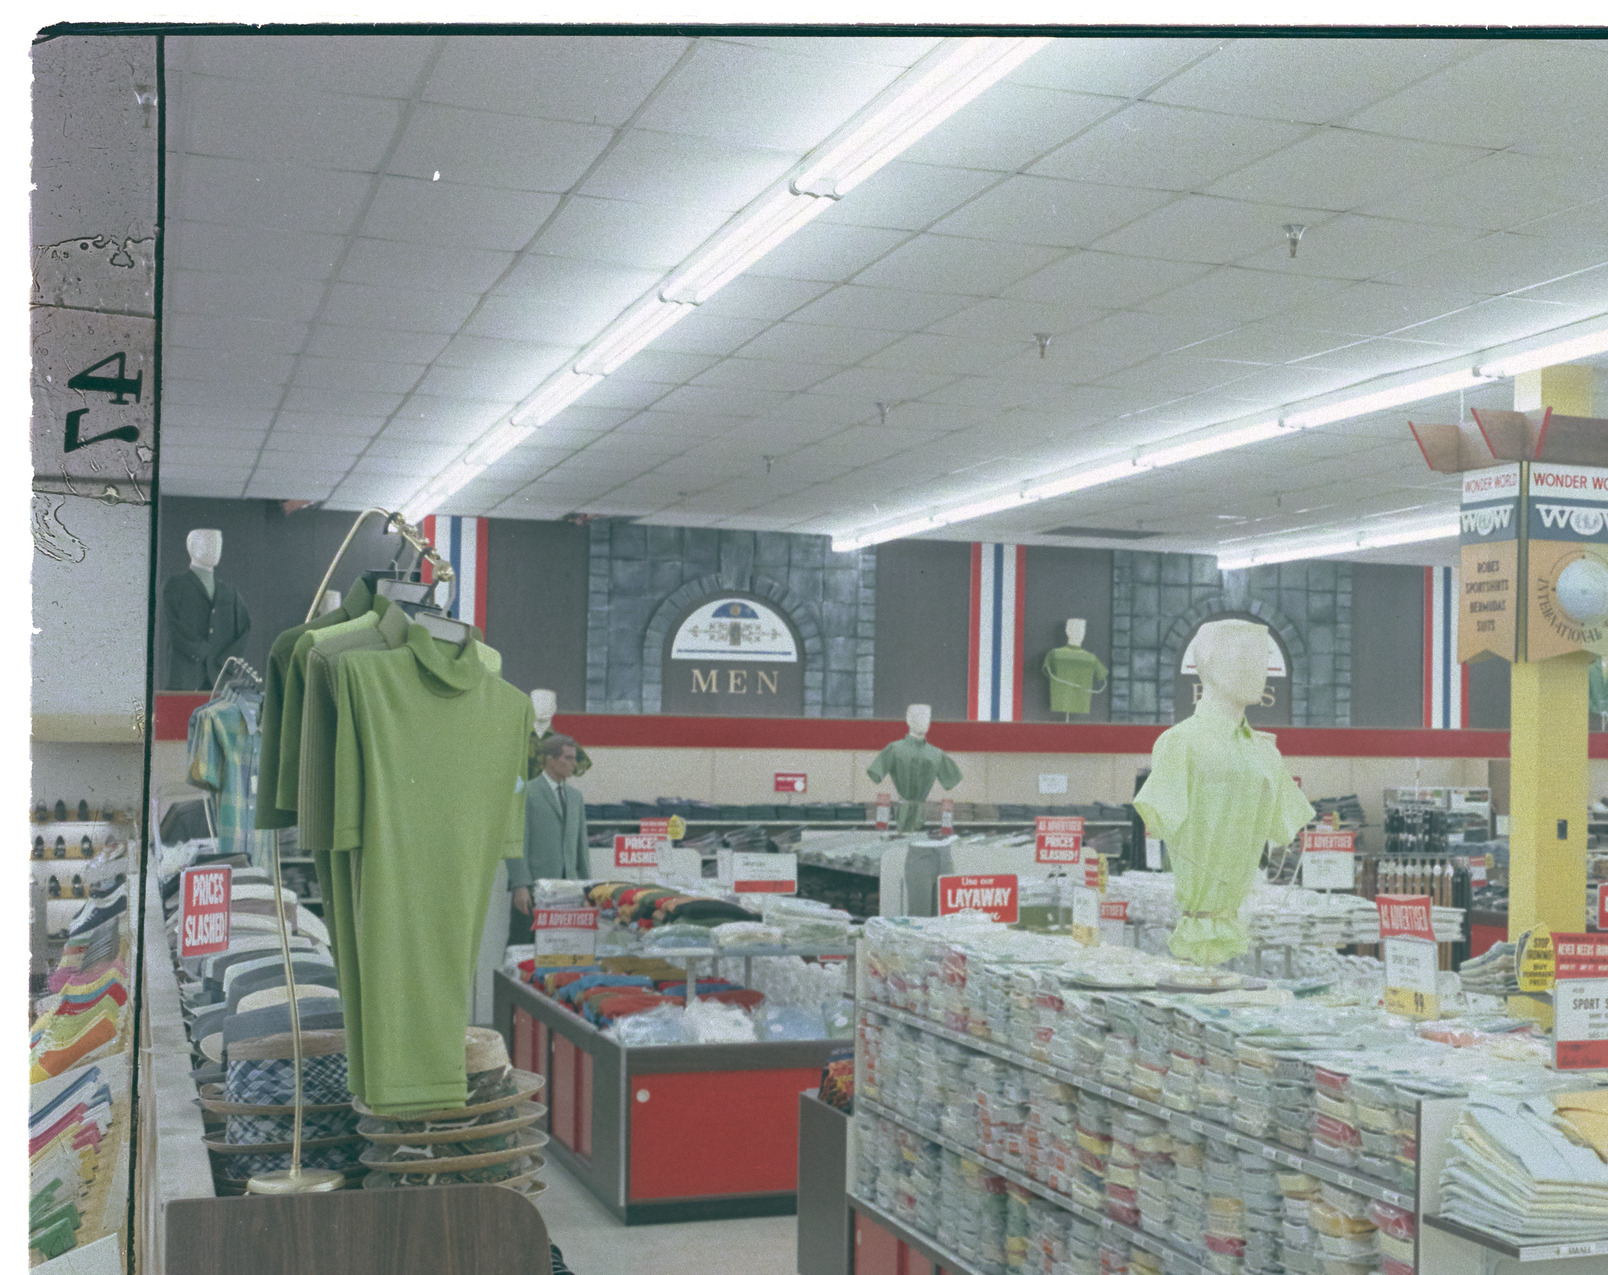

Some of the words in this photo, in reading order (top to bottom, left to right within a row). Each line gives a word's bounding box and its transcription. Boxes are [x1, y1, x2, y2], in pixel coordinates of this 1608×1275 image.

[1465, 477, 1493, 493] WONDER
[1494, 473, 1518, 488] WORLD
[1533, 473, 1588, 489] WONDER
[1465, 579, 1509, 594] SPORTSHIRTS
[1469, 600, 1506, 613] BERMUDAS
[1536, 577, 1603, 643] INTERNATIONAL
[1476, 619, 1495, 632] SUITS
[690, 669, 779, 694] MEN
[625, 837, 657, 850] PRICE
[1044, 836, 1075, 847] PRICES
[618, 852, 657, 865] SLASHE
[1039, 849, 1079, 861] SLASHED!
[192, 872, 225, 907] PRICES
[947, 888, 1011, 908] LAYAWAY
[549, 912, 595, 926] ADVERTISED
[1390, 904, 1429, 932] ADVERTISED
[184, 912, 228, 948] SLASHED!
[1572, 998, 1600, 1011] SPORT
